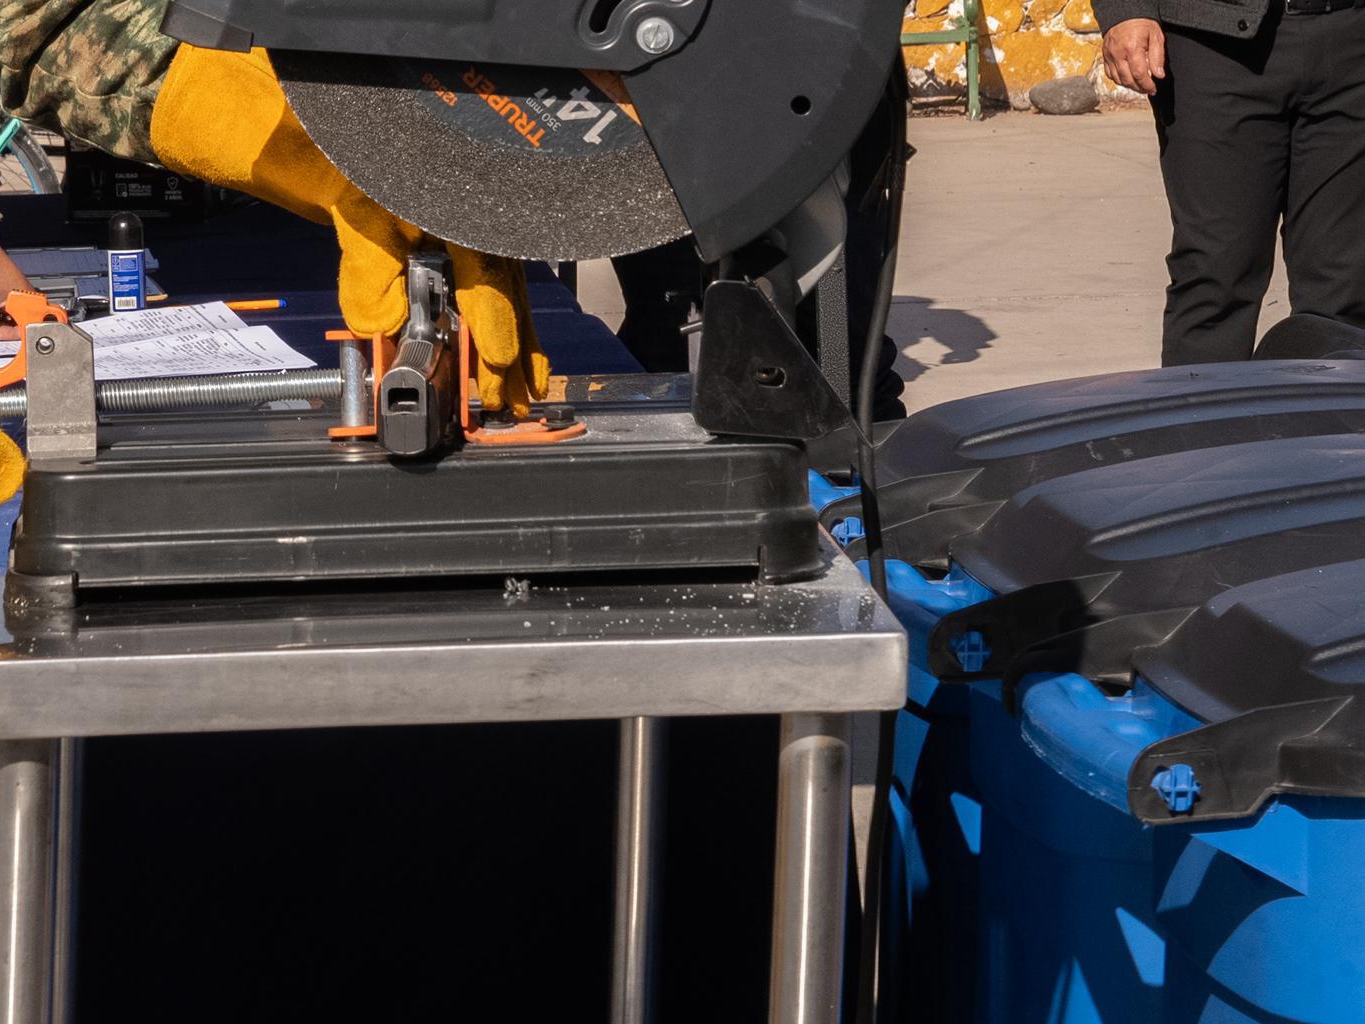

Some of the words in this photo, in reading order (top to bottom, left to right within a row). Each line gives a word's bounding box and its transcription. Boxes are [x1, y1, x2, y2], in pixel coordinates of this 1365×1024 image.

[460, 64, 546, 148] TRUPER
[525, 97, 544, 115] mm
[541, 111, 563, 132] 350
